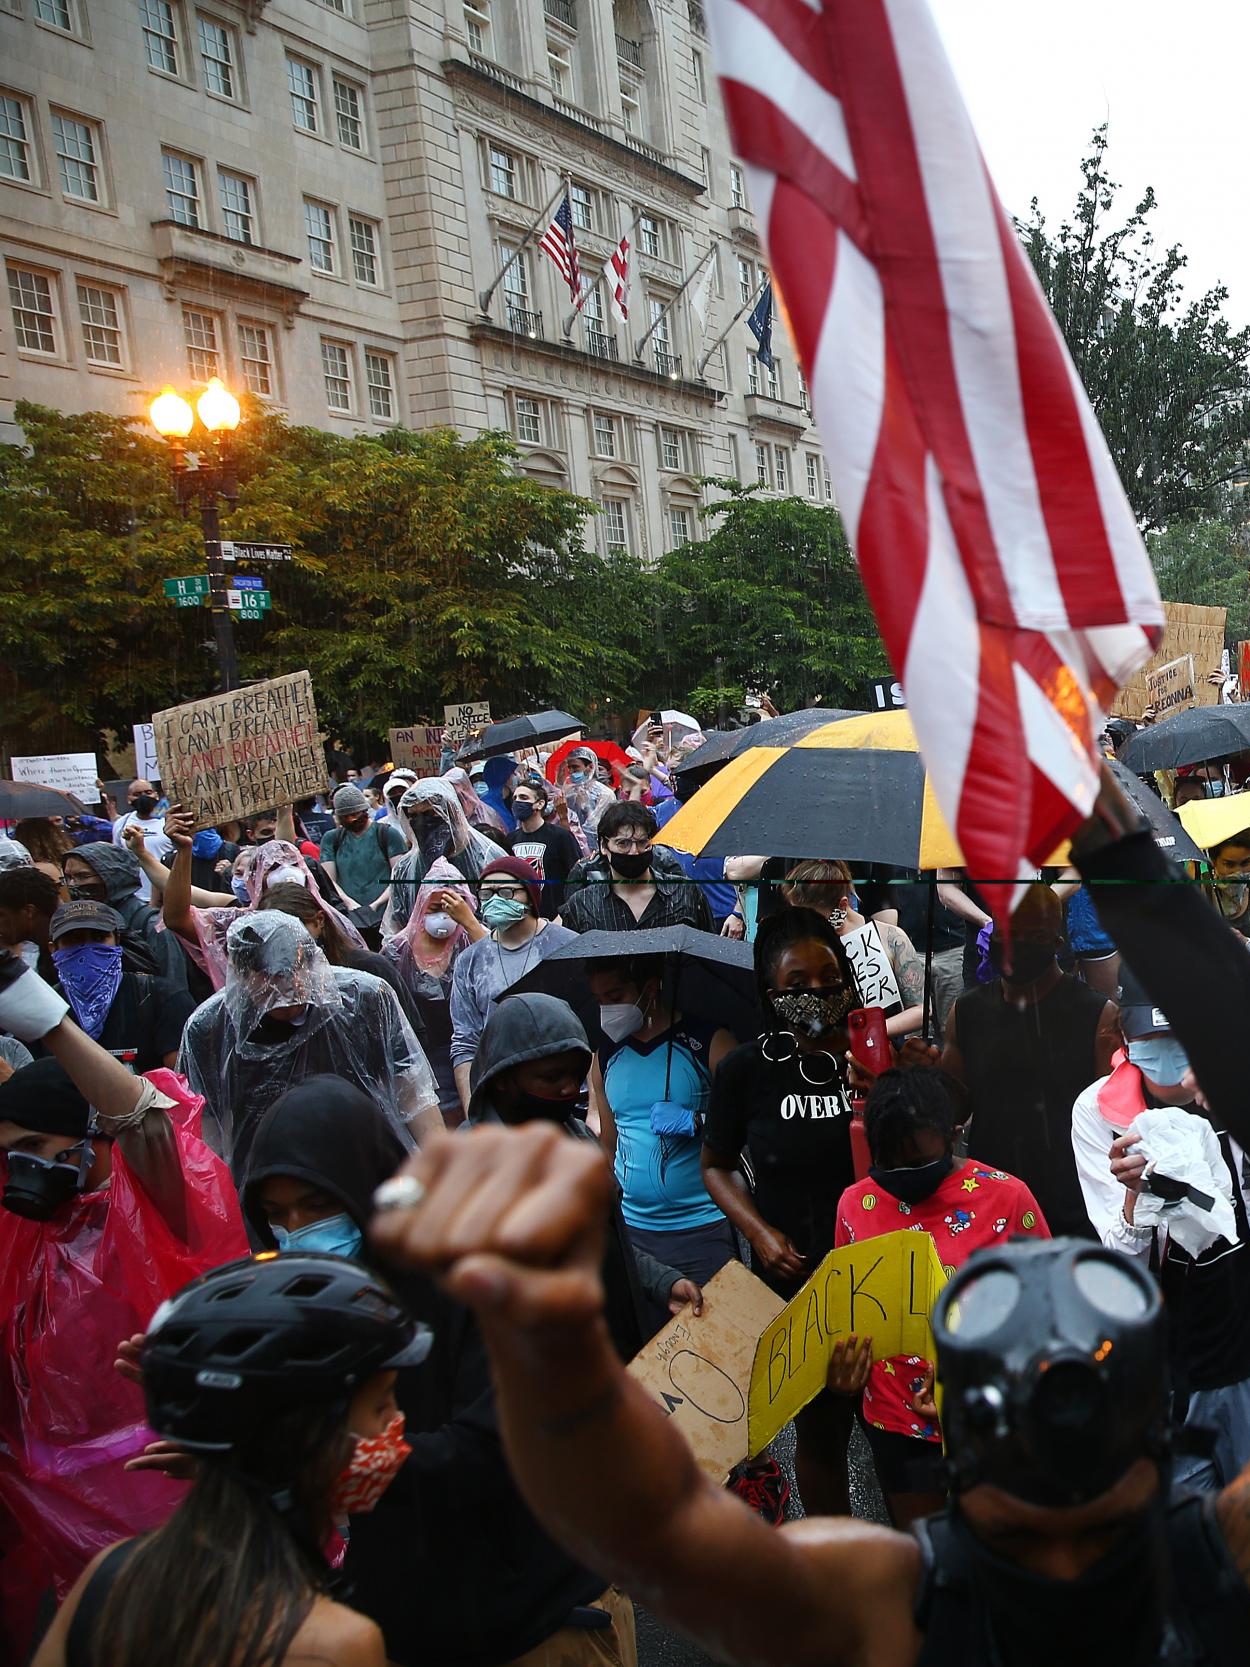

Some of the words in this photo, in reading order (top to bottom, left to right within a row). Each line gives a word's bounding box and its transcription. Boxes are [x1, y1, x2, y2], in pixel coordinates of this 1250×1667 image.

[234, 546, 250, 559] Black
[251, 547, 266, 559] Lives
[265, 549, 283, 560] Matter
[177, 580, 187, 595] H
[179, 595, 200, 607] 1600
[244, 594, 257, 607] 16
[240, 609, 260, 619] 800
[164, 718, 175, 739] I
[180, 702, 228, 735] CAN'T
[232, 678, 311, 719] BREATHE!
[458, 706, 474, 717] NO
[1154, 684, 1195, 714] REONNA
[165, 740, 173, 760] I
[177, 725, 222, 756] CAN'T
[229, 701, 312, 741] BREATHE!
[448, 713, 490, 727] JUSTICE
[231, 722, 313, 765] BREATHE!
[396, 730, 415, 743] AN
[235, 746, 317, 786] BREATHE!
[239, 766, 322, 807] BREATHE!
[861, 975, 898, 1005] ER.
[780, 1093, 841, 1120] OVER
[769, 1256, 887, 1405] BLACK
